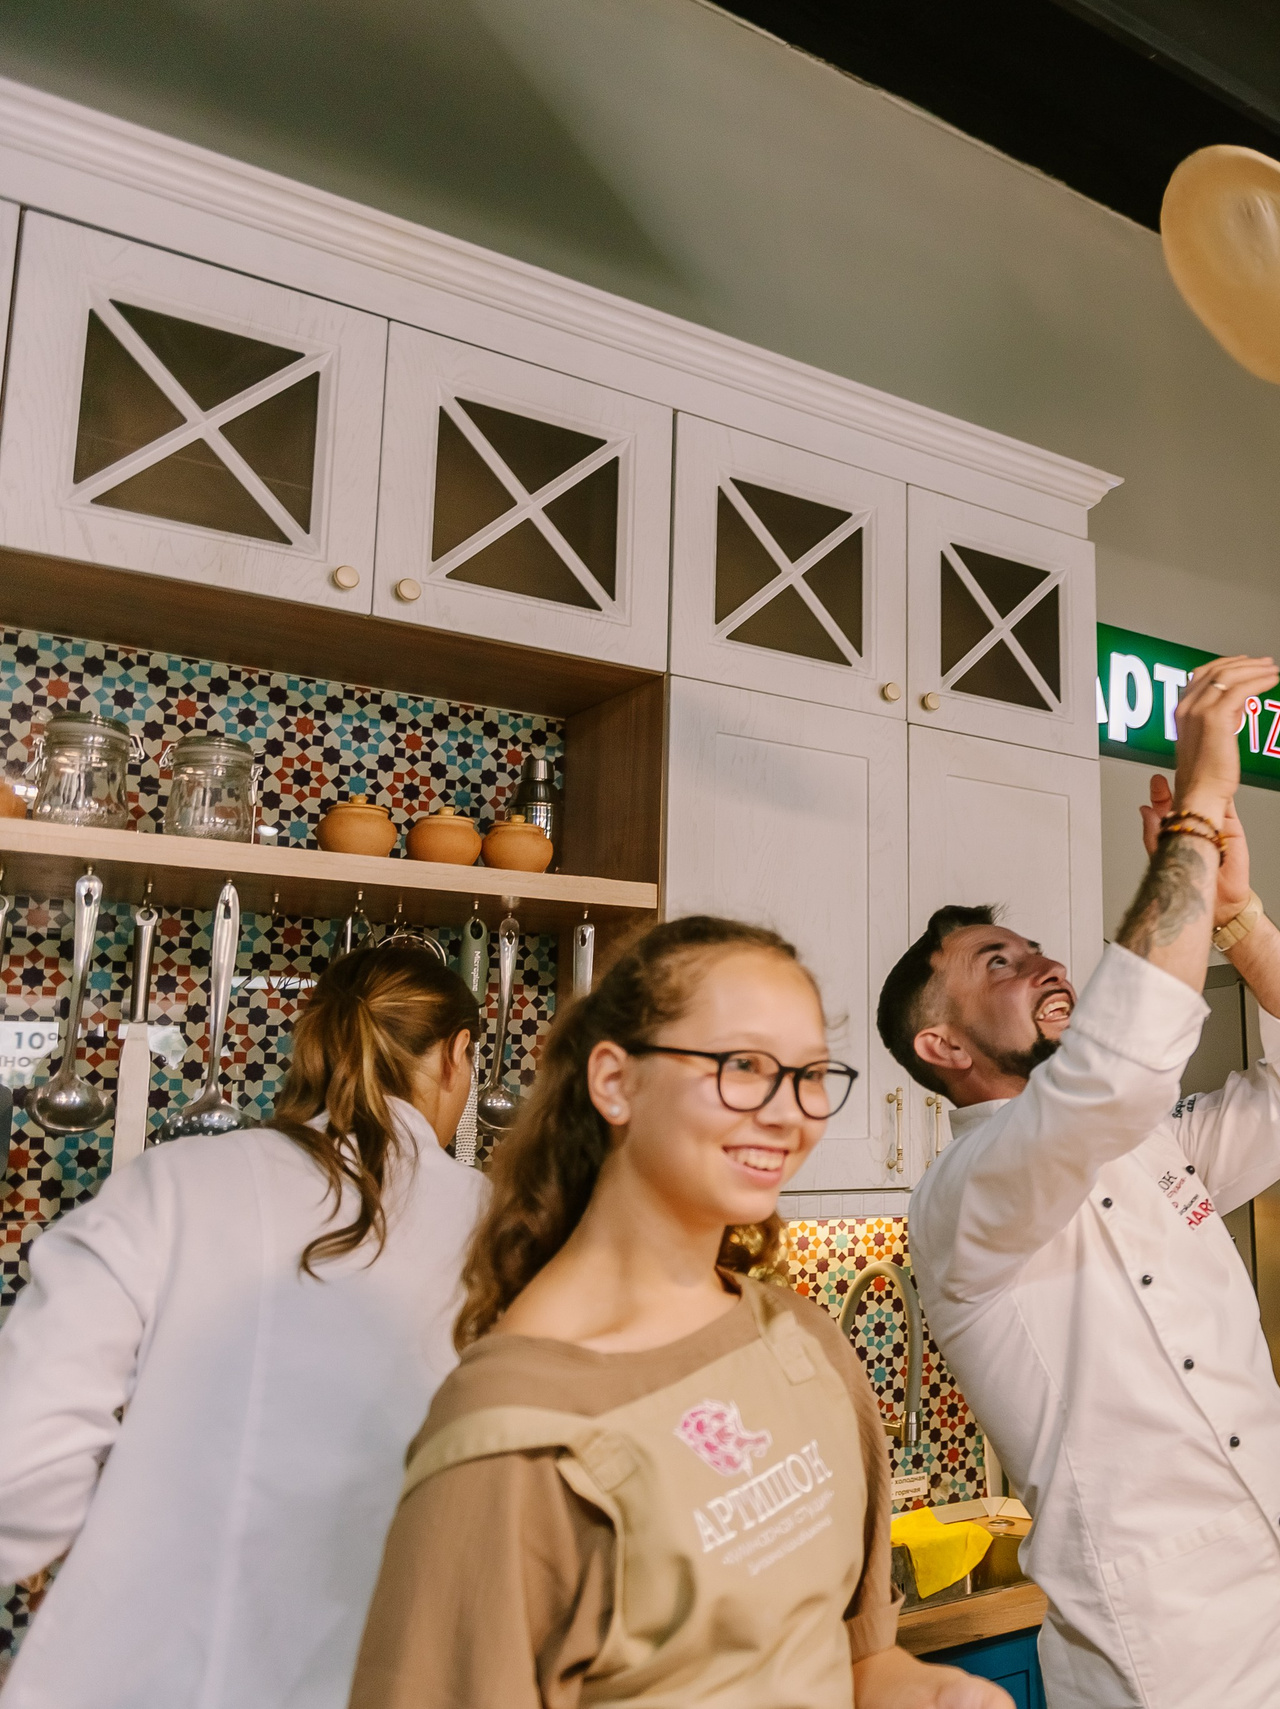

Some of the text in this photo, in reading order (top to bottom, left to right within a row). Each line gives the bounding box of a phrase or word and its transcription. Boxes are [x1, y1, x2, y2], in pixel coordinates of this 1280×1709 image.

[471, 950, 481, 992] Microplane
[1158, 1171, 1178, 1193] ОК
[693, 1439, 833, 1553] АРТИШОК
